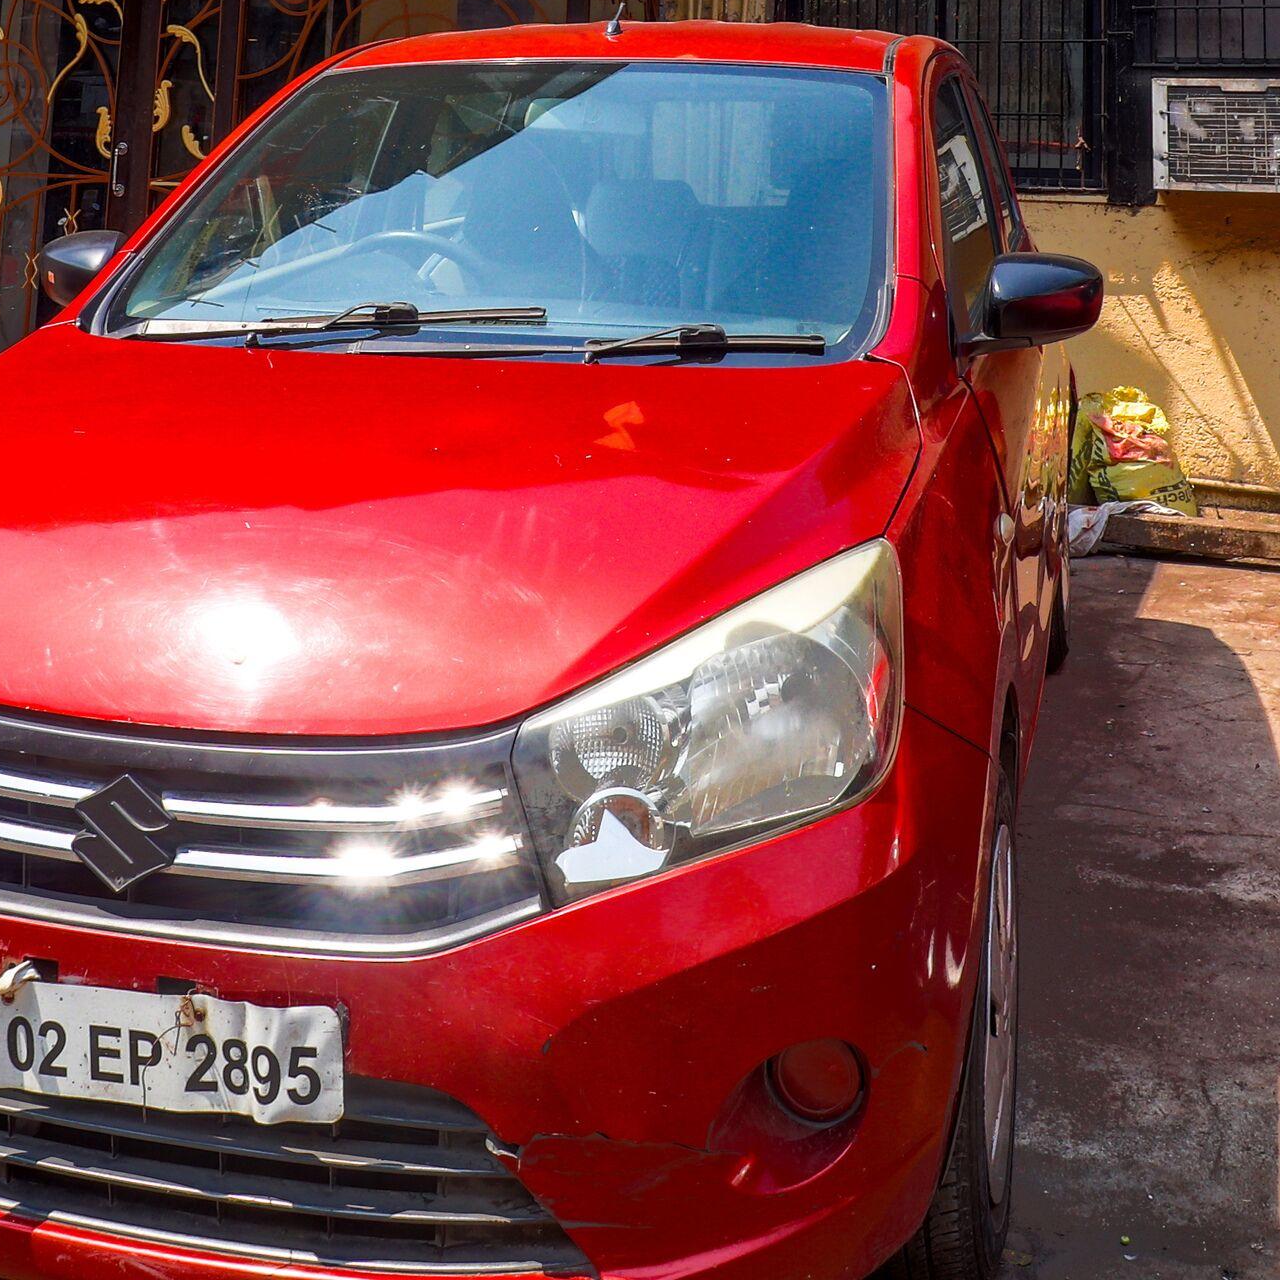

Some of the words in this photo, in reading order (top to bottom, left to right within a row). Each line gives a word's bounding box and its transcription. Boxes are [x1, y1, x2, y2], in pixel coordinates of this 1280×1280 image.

[7, 1015, 68, 1078] 02
[89, 1024, 163, 1087] EP
[184, 1032, 322, 1106] 2895
